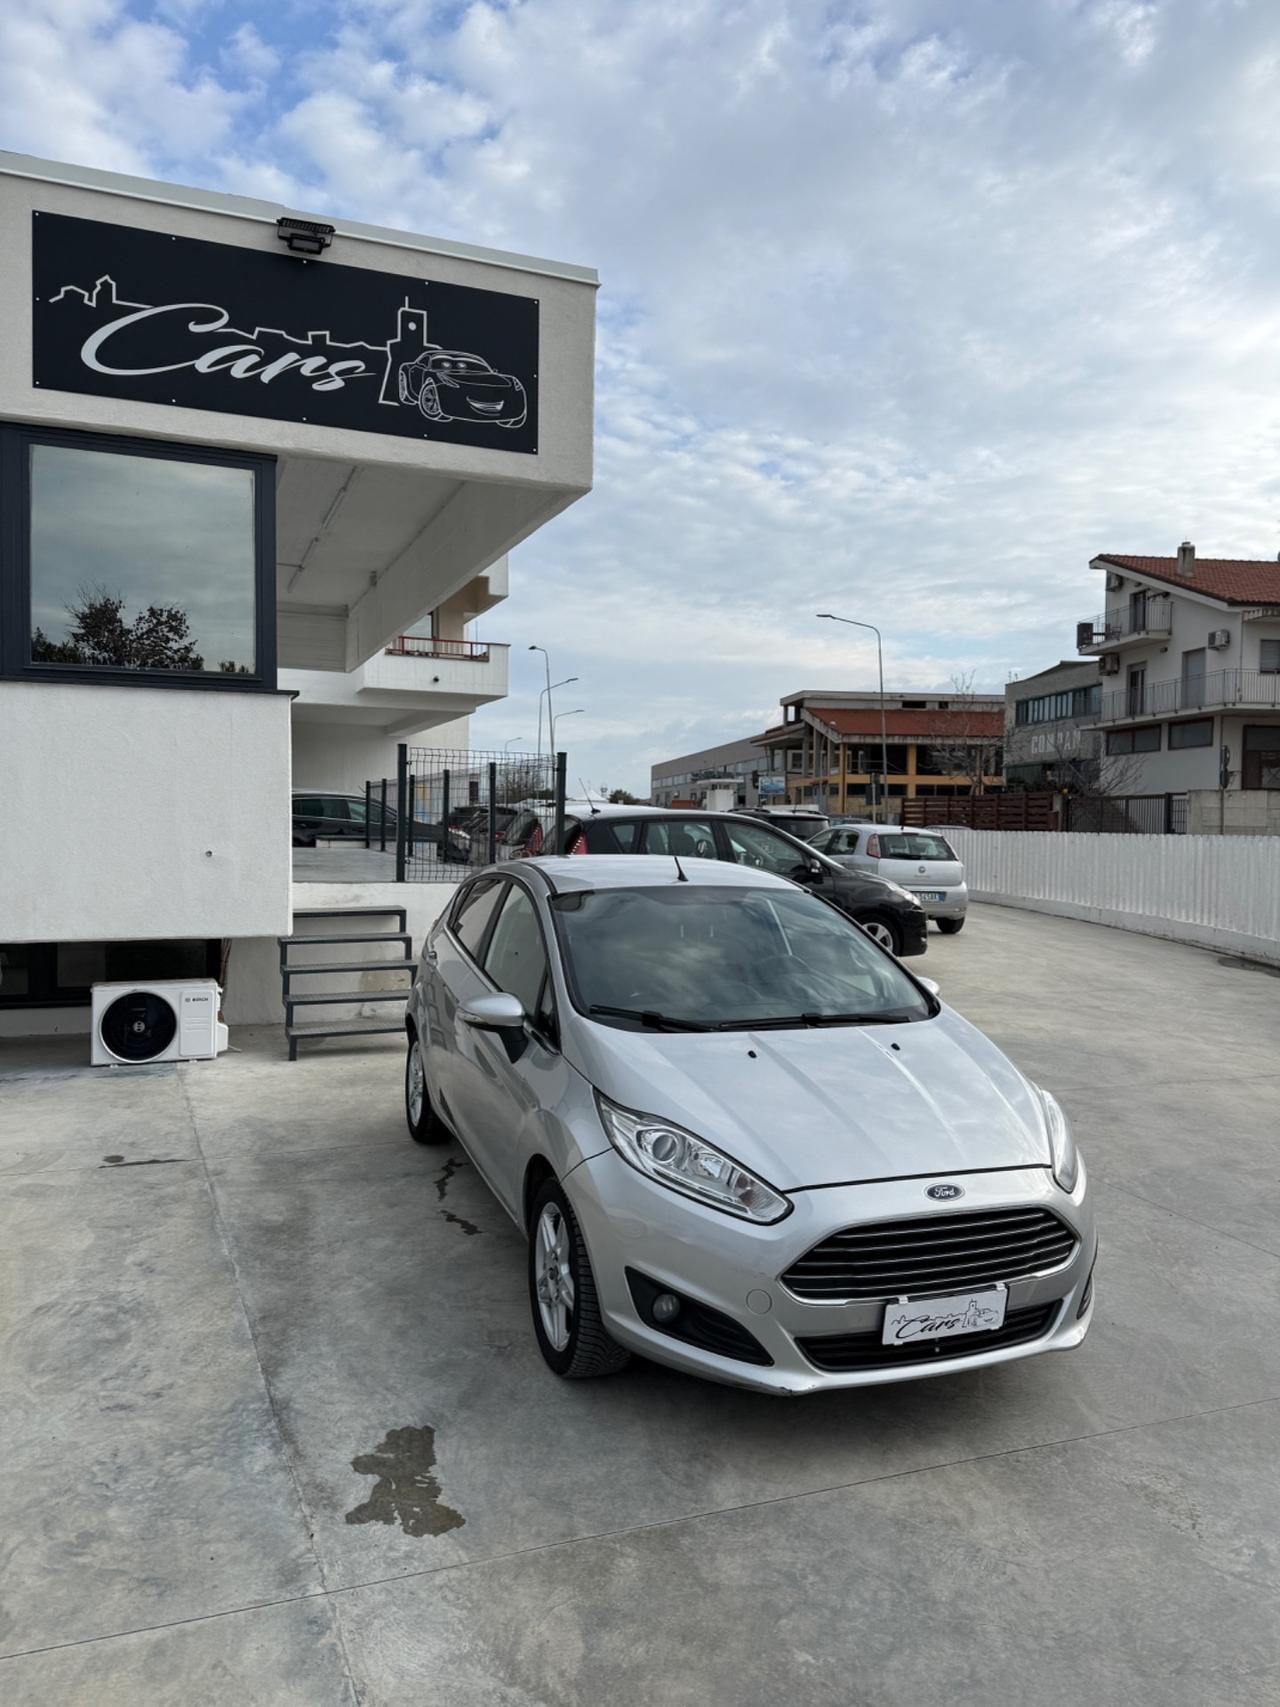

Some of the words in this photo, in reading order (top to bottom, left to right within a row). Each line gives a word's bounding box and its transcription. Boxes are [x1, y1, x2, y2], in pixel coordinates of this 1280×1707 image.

[81, 303, 376, 391] Cars
[934, 1186, 956, 1198] Ford
[896, 1315, 960, 1339] Cars
